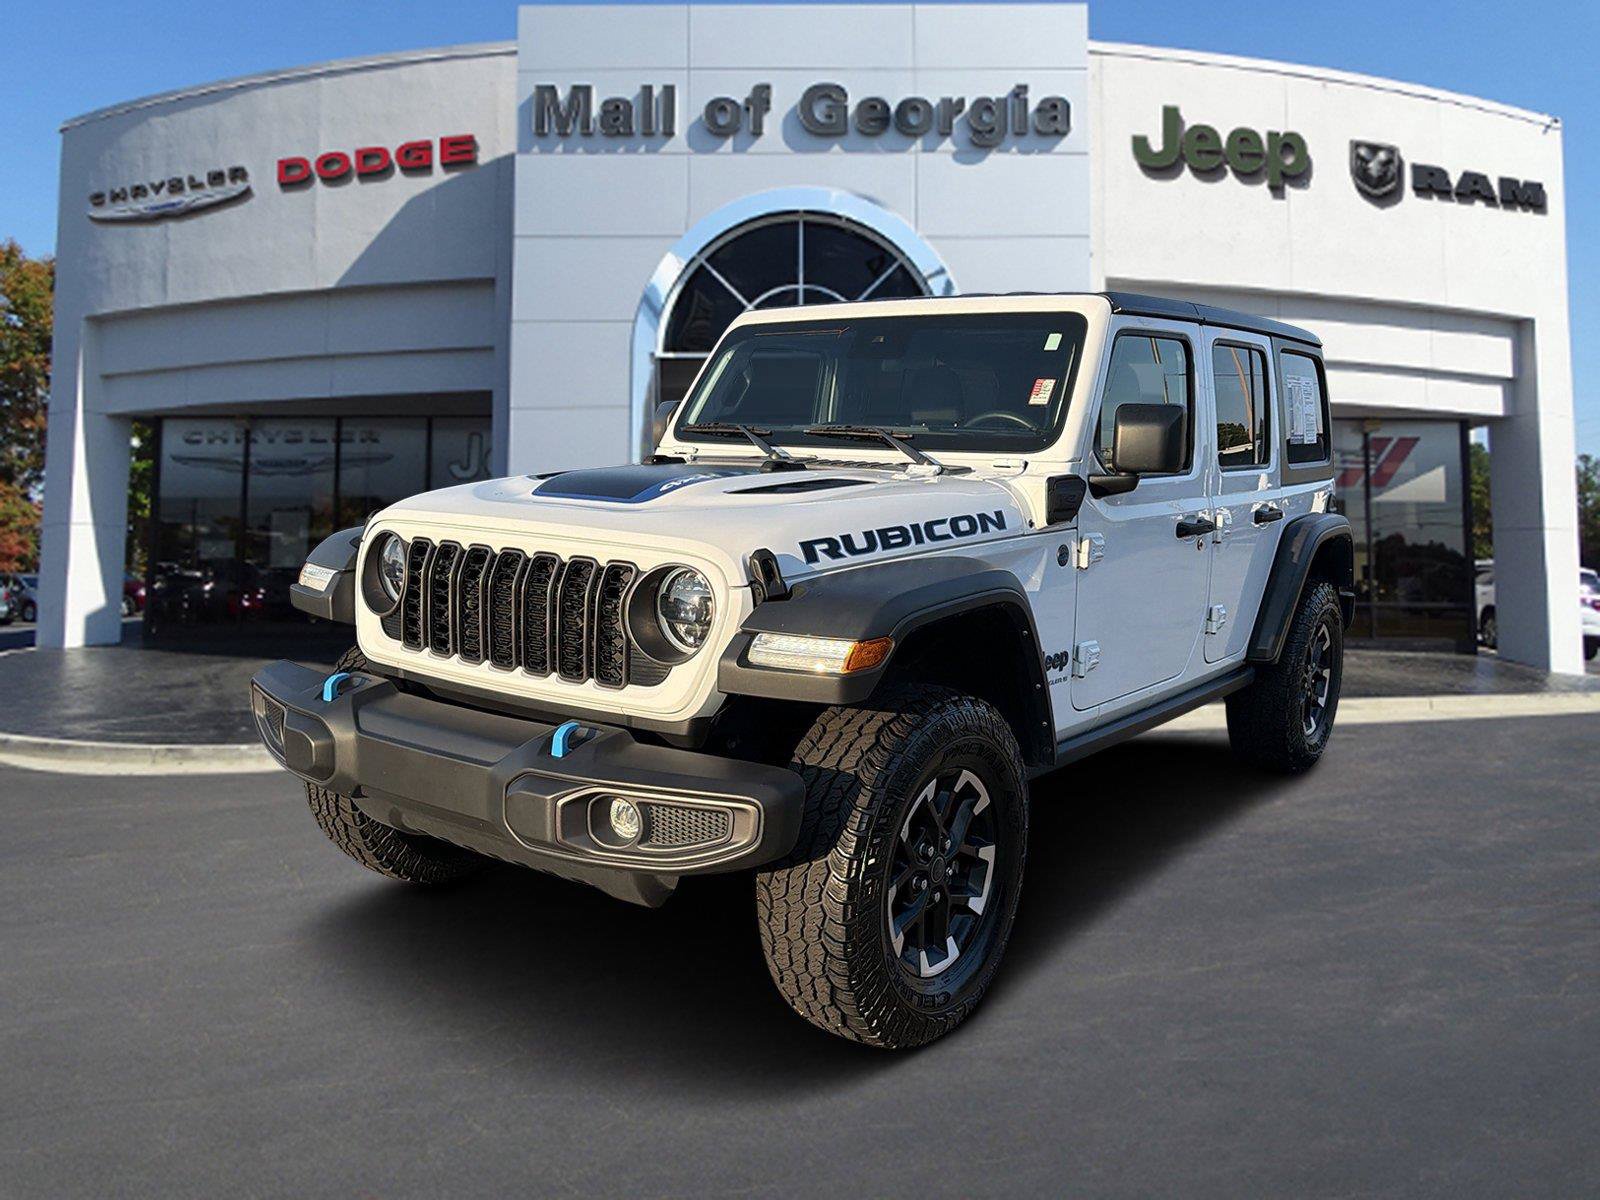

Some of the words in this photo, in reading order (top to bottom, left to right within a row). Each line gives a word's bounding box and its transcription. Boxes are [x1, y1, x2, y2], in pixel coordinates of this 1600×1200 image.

[533, 84, 676, 137] Mall
[704, 83, 772, 137] of
[800, 82, 1072, 148] Georgia
[277, 134, 478, 187] DODGE
[1131, 105, 1310, 189] Jeep
[89, 166, 249, 207] CHRYSLER
[1411, 163, 1547, 210] RAM
[799, 510, 1008, 565] RUBICON
[1042, 650, 1069, 672] eep
